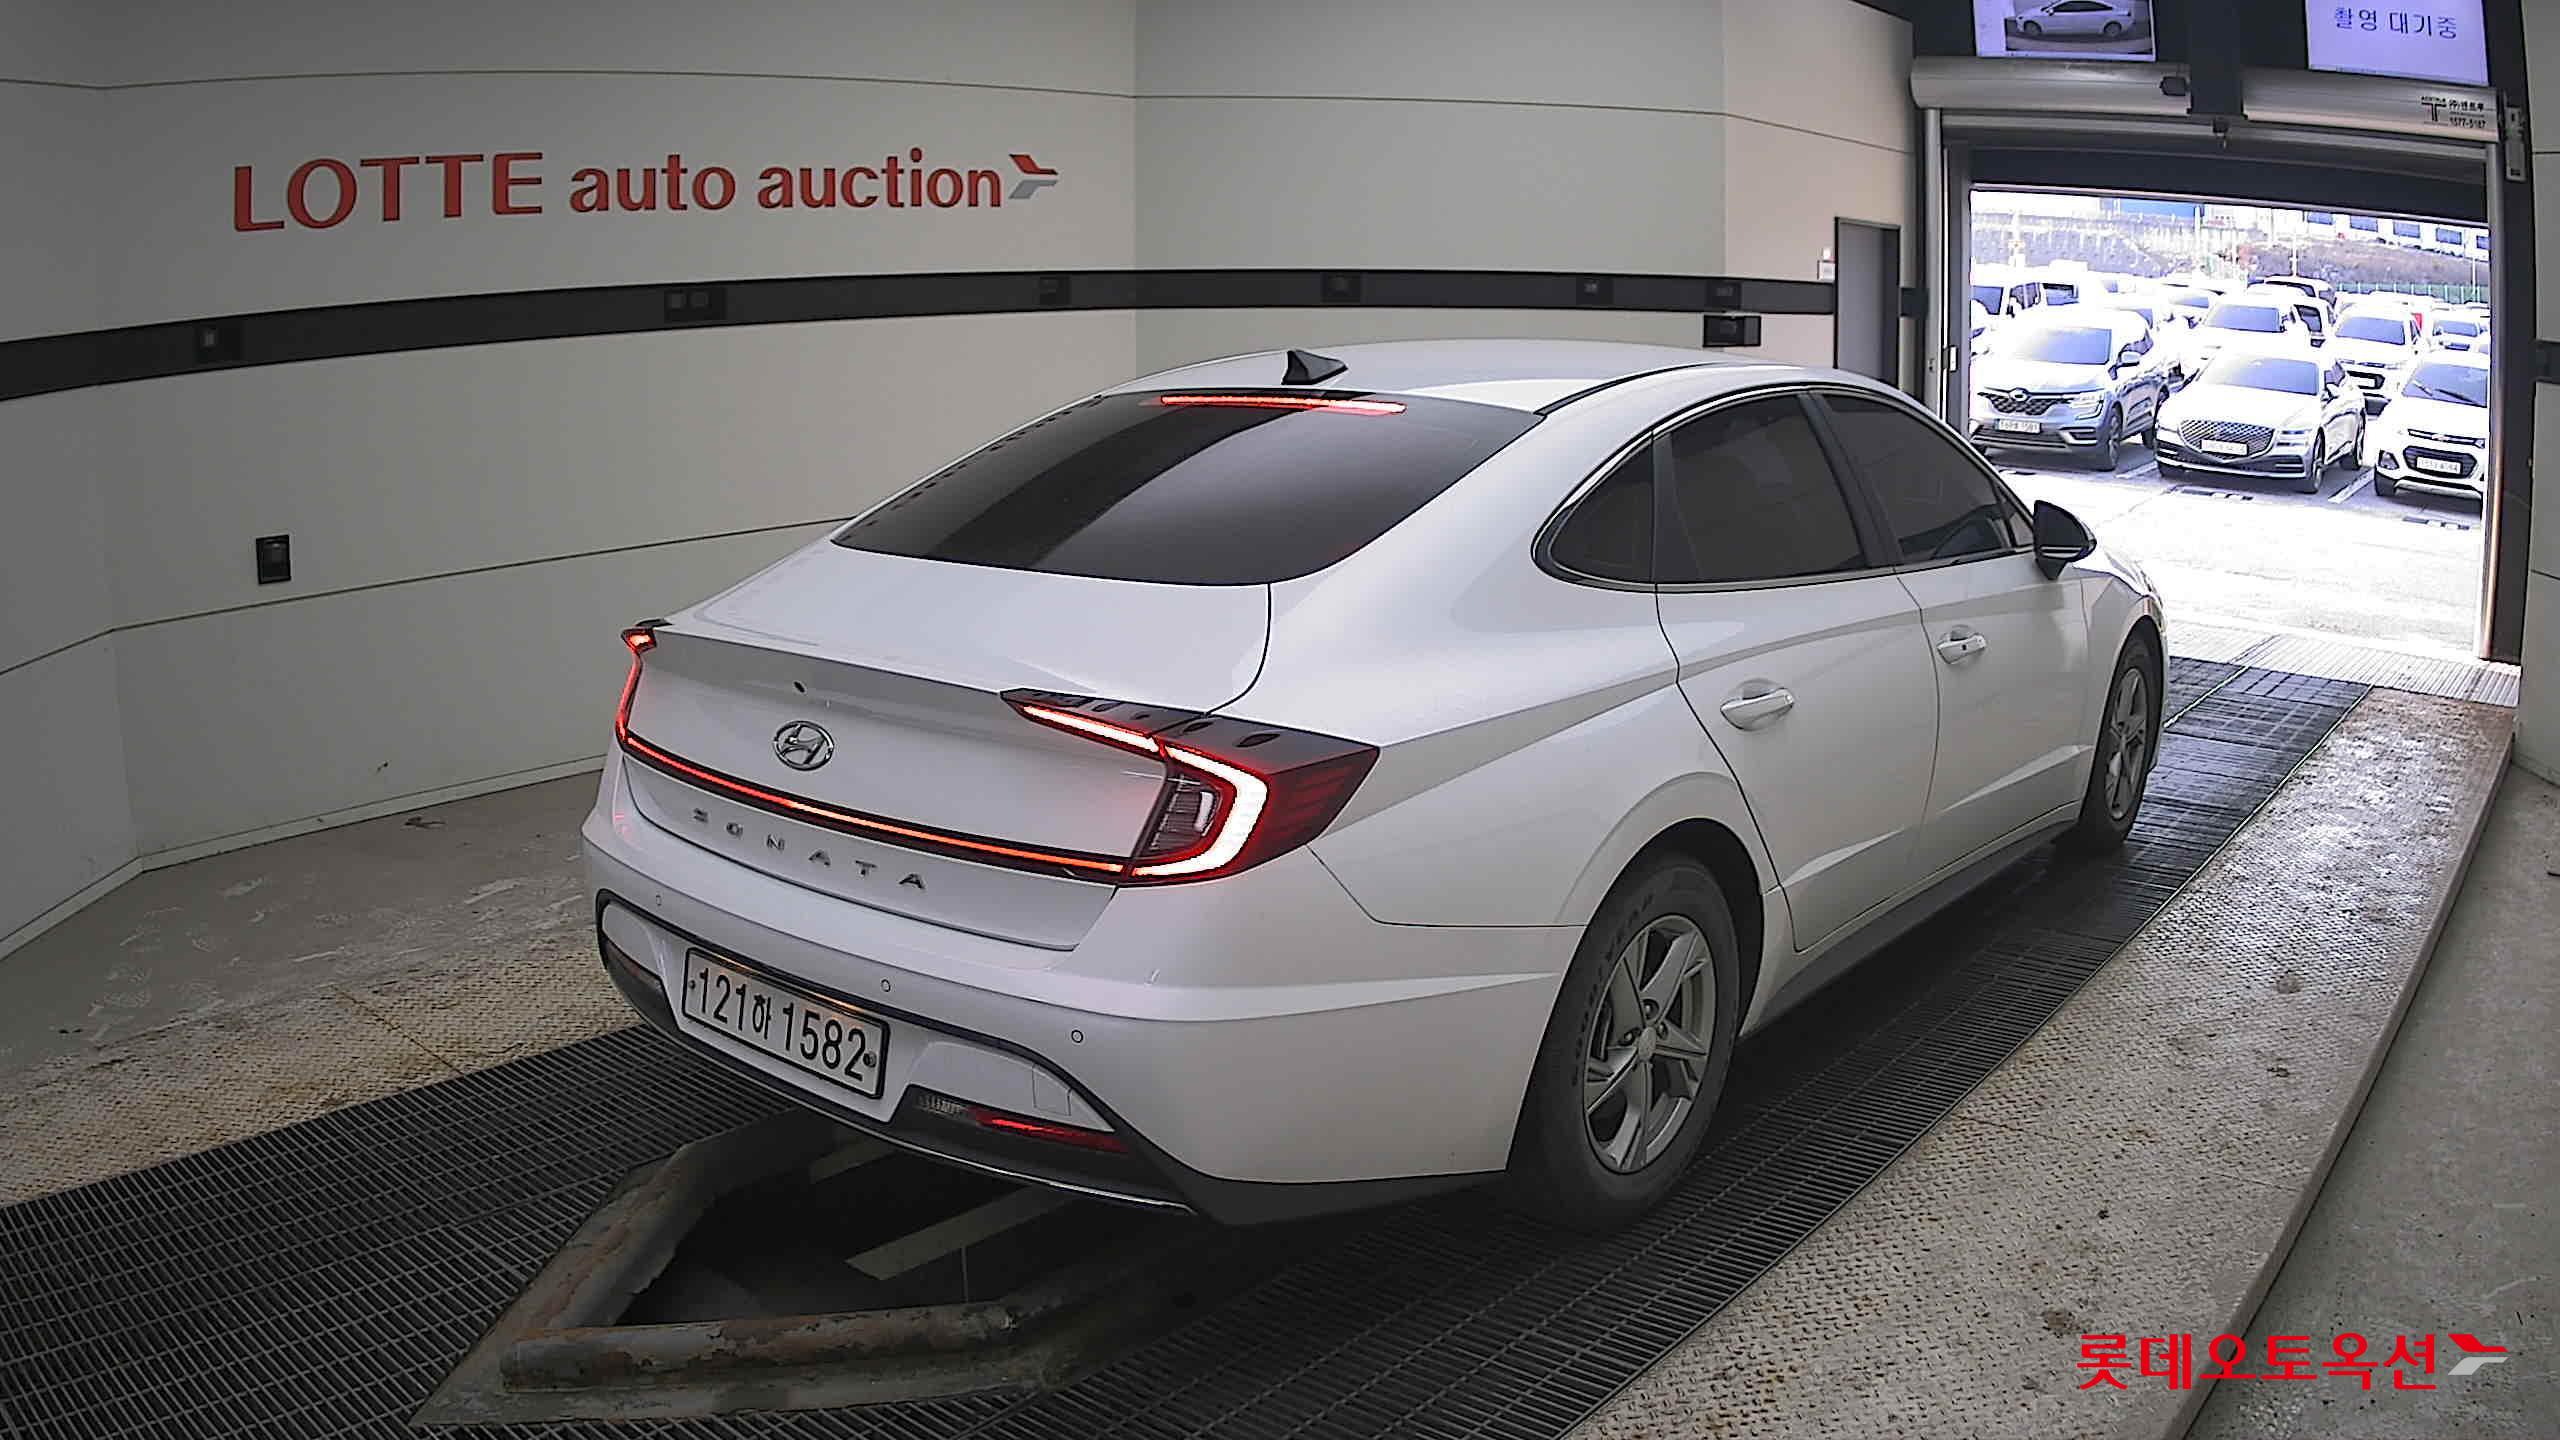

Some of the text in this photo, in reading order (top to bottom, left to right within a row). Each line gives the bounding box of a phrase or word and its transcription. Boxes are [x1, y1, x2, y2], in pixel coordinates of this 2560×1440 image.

[2335, 7, 2457, 40] 촬영 대기중
[234, 148, 1002, 232] LOTTE auto auction
[692, 807, 927, 891] SONATA
